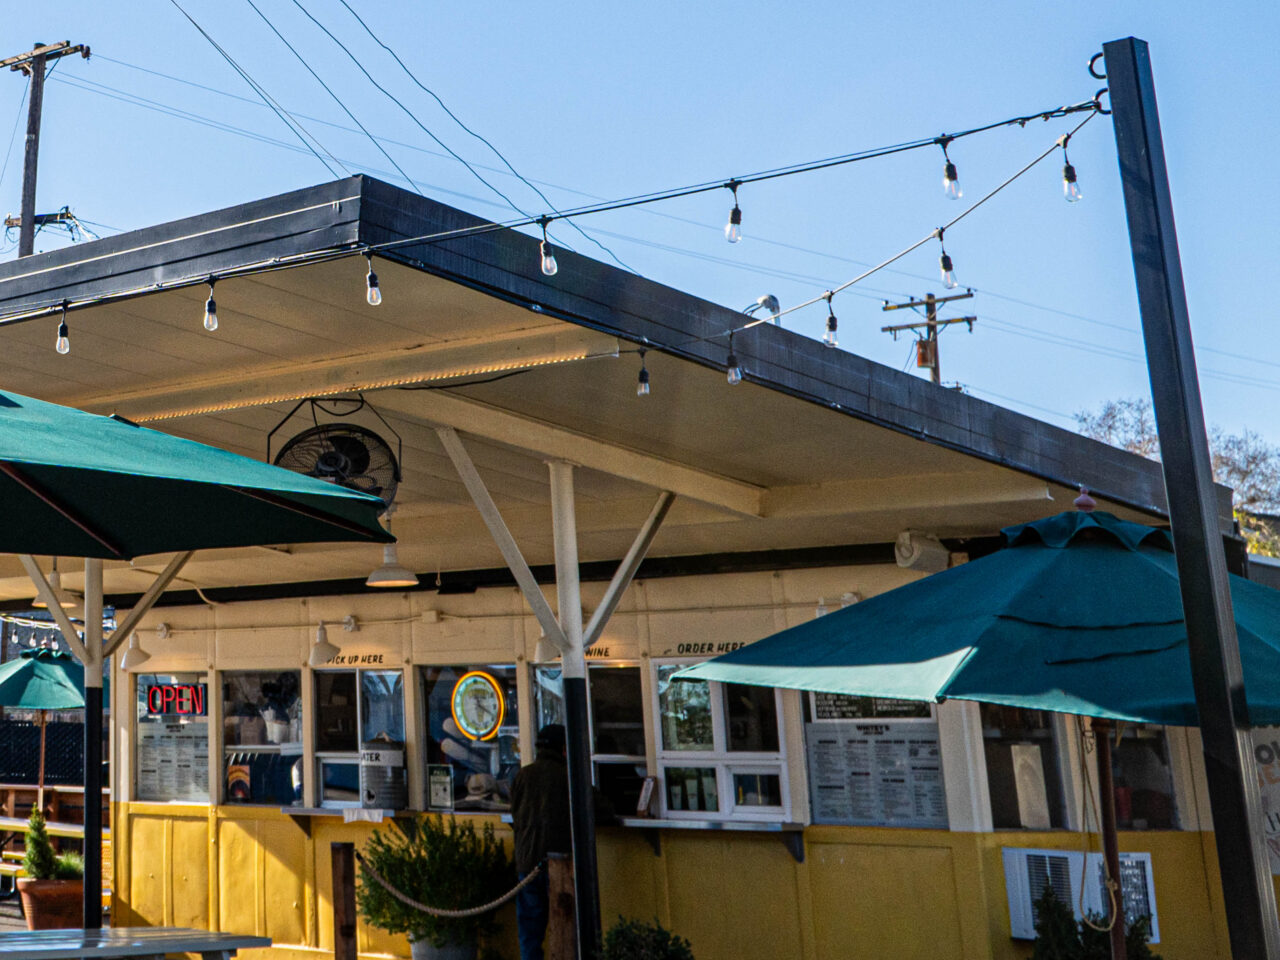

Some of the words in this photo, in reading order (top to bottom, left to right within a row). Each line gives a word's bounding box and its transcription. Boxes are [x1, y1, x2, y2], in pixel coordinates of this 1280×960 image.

[677, 642, 714, 655] ORDER
[348, 655, 360, 665] UP
[361, 654, 385, 665] HERE
[148, 686, 204, 714] OPEN
